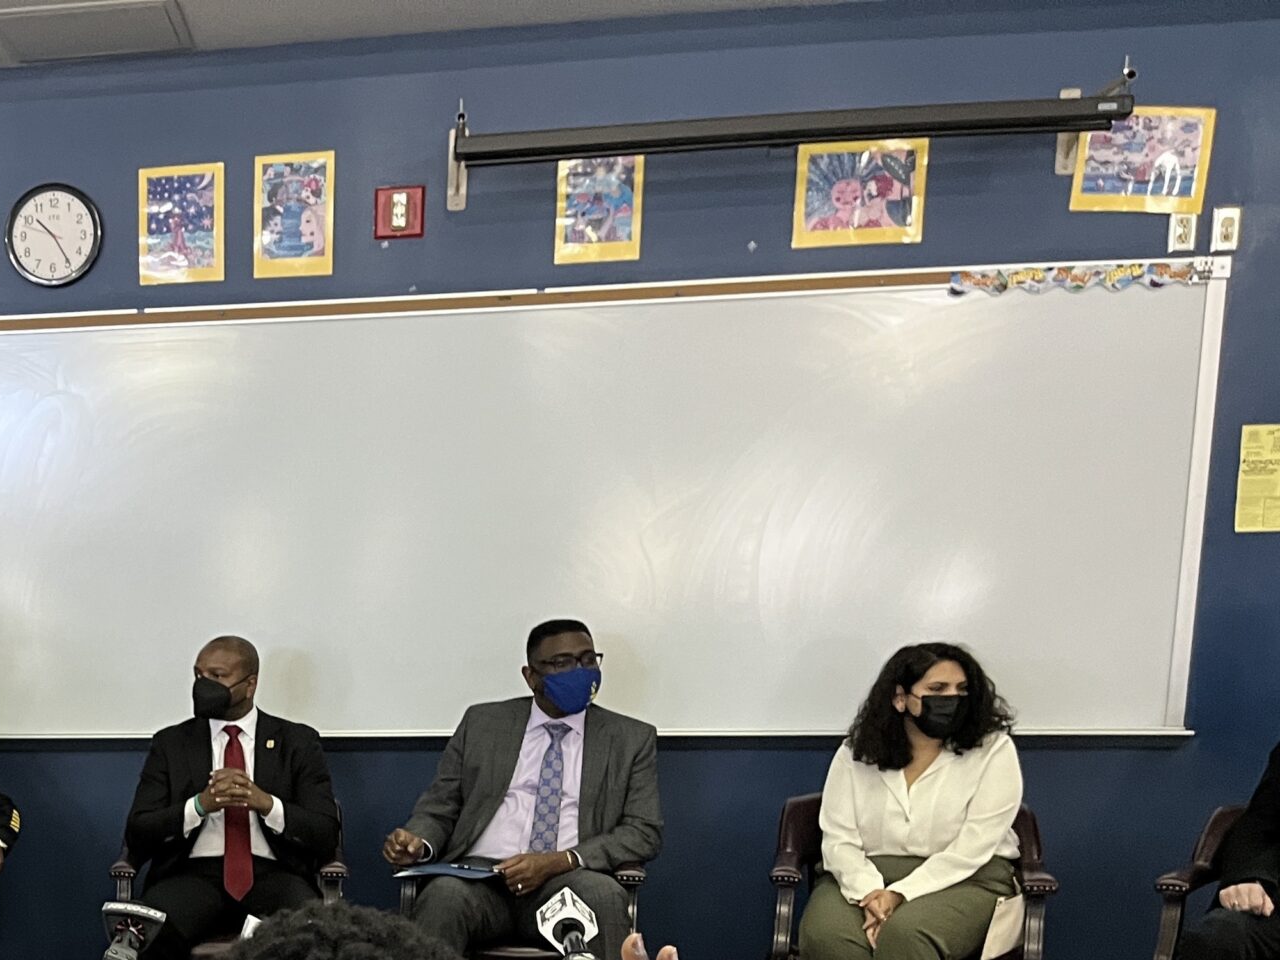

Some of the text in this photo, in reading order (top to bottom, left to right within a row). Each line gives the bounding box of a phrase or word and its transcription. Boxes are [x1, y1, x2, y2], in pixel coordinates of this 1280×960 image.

[35, 202, 43, 213] 11
[49, 198, 59, 208] 12
[66, 202, 71, 212] 1
[24, 215, 34, 225] 10
[76, 213, 83, 225] 2
[20, 231, 27, 242] 9
[80, 230, 87, 240] 3
[24, 247, 31, 258] 8
[76, 246, 82, 256] 4
[35, 259, 42, 270] 7
[49, 262, 56, 273] 6
[65, 259, 72, 269] 5
